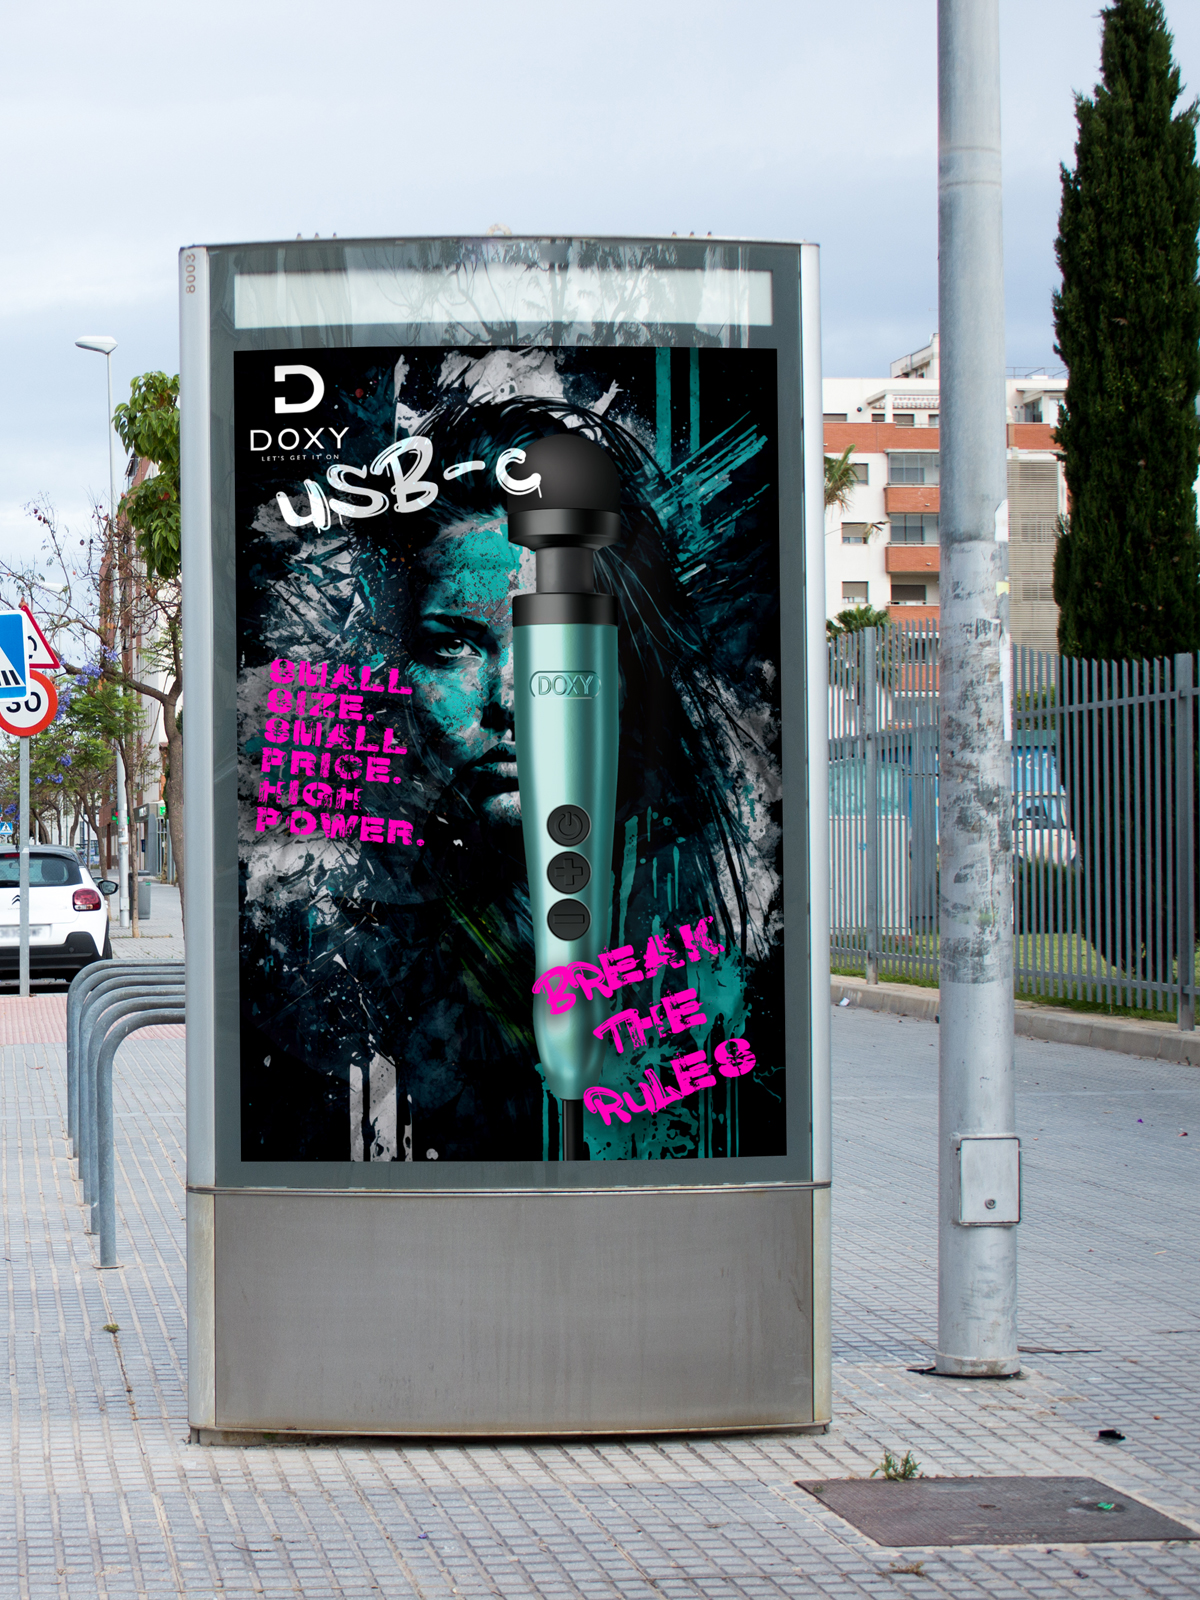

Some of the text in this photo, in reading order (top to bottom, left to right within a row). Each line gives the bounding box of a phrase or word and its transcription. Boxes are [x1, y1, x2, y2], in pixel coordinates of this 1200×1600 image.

[185, 253, 196, 294] 8003
[250, 426, 350, 452] DOXY
[269, 658, 413, 695] SMALL
[538, 675, 594, 696] DOXY
[266, 688, 375, 722] SIZE.
[264, 718, 408, 755] SMALL
[261, 747, 402, 783] PRICE.
[257, 777, 364, 810] HIGH
[255, 806, 425, 846] POWER.
[532, 915, 725, 1015] BREAK
[593, 987, 708, 1054] THE
[583, 1038, 756, 1126] RULES
